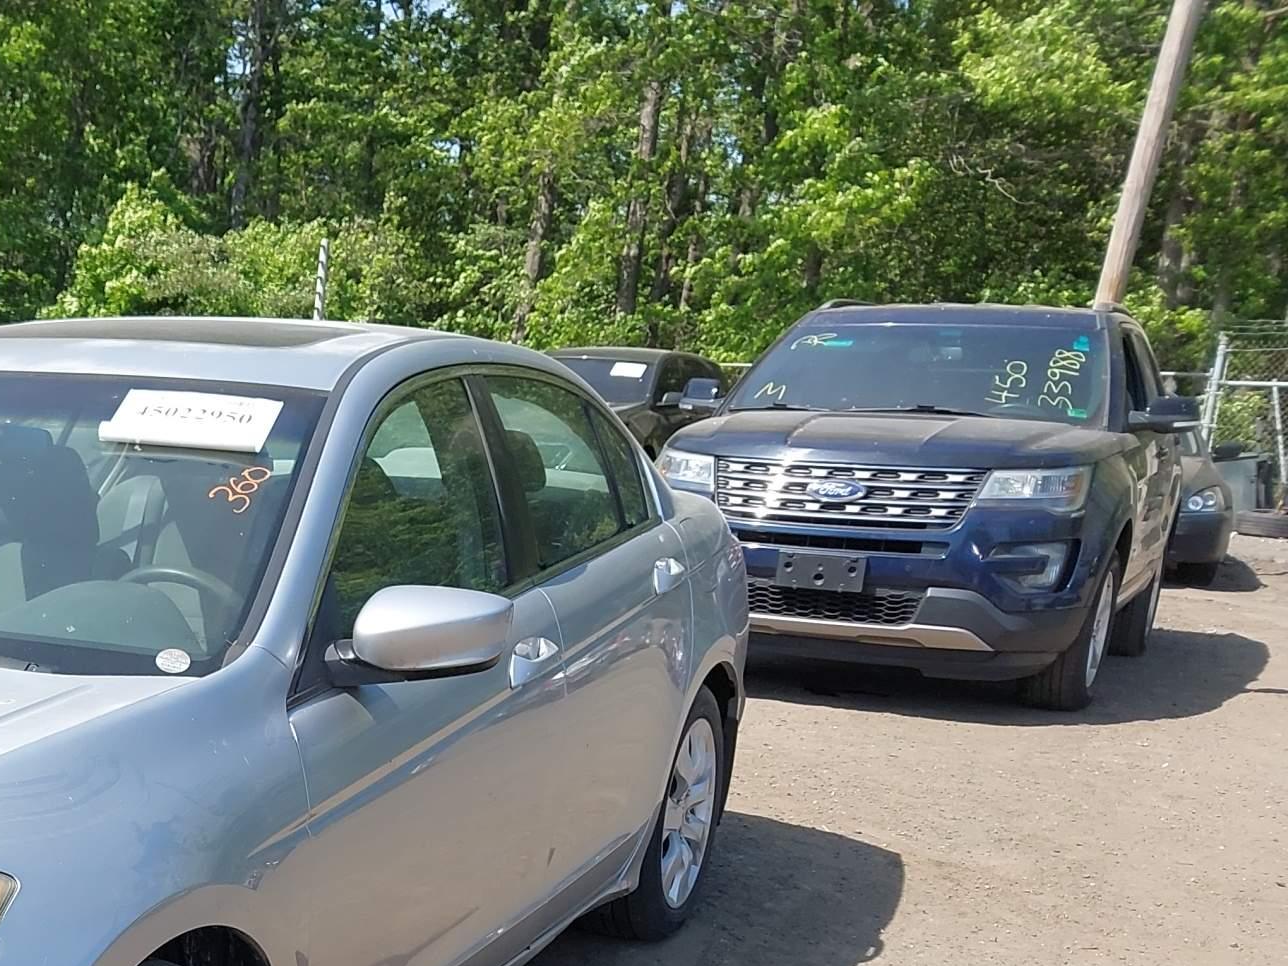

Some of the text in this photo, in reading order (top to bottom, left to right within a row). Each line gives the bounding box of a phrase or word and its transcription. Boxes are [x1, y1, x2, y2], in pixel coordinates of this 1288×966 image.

[983, 359, 1028, 404] 450
[1037, 348, 1087, 410] 33988
[136, 405, 254, 425] 45022950
[208, 466, 272, 514] 360
[817, 482, 853, 497] Ford
